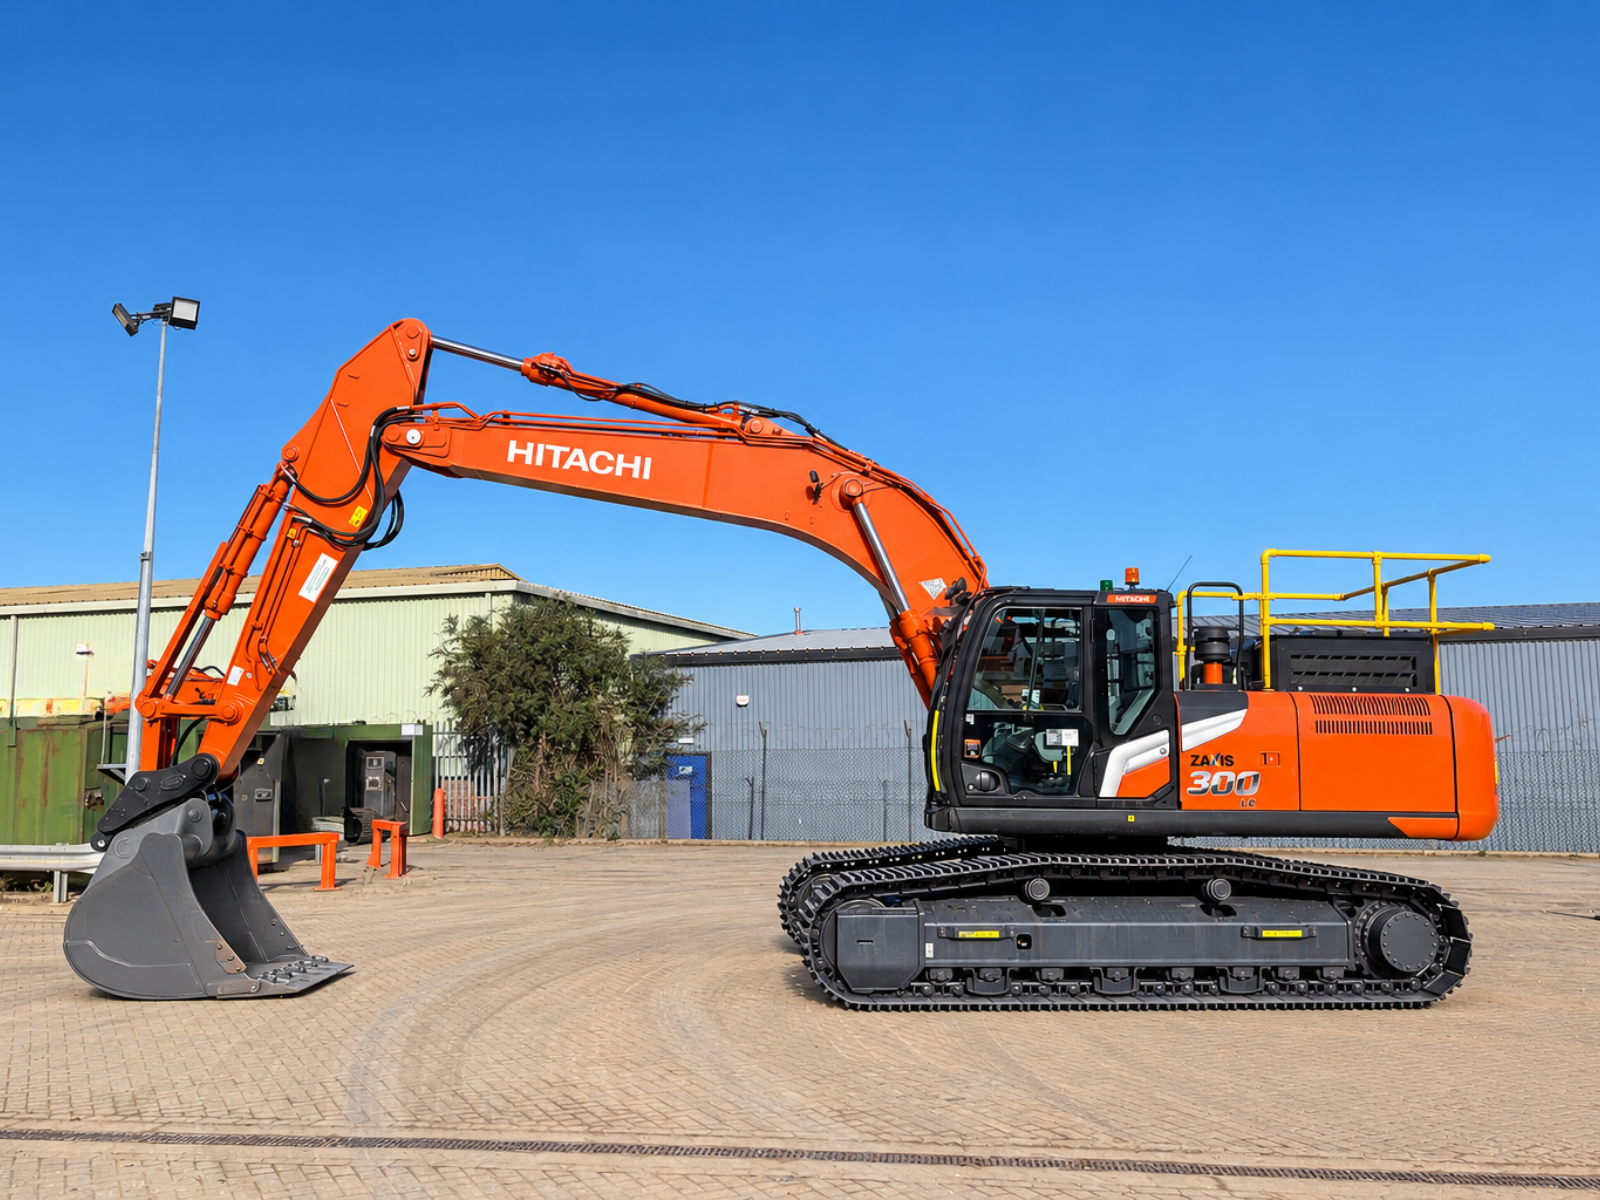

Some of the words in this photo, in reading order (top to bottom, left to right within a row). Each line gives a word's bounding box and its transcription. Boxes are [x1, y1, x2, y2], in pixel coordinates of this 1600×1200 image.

[507, 440, 652, 480] HITACHI
[1190, 753, 1234, 767] ZAXIS
[1187, 771, 1261, 796] 300
